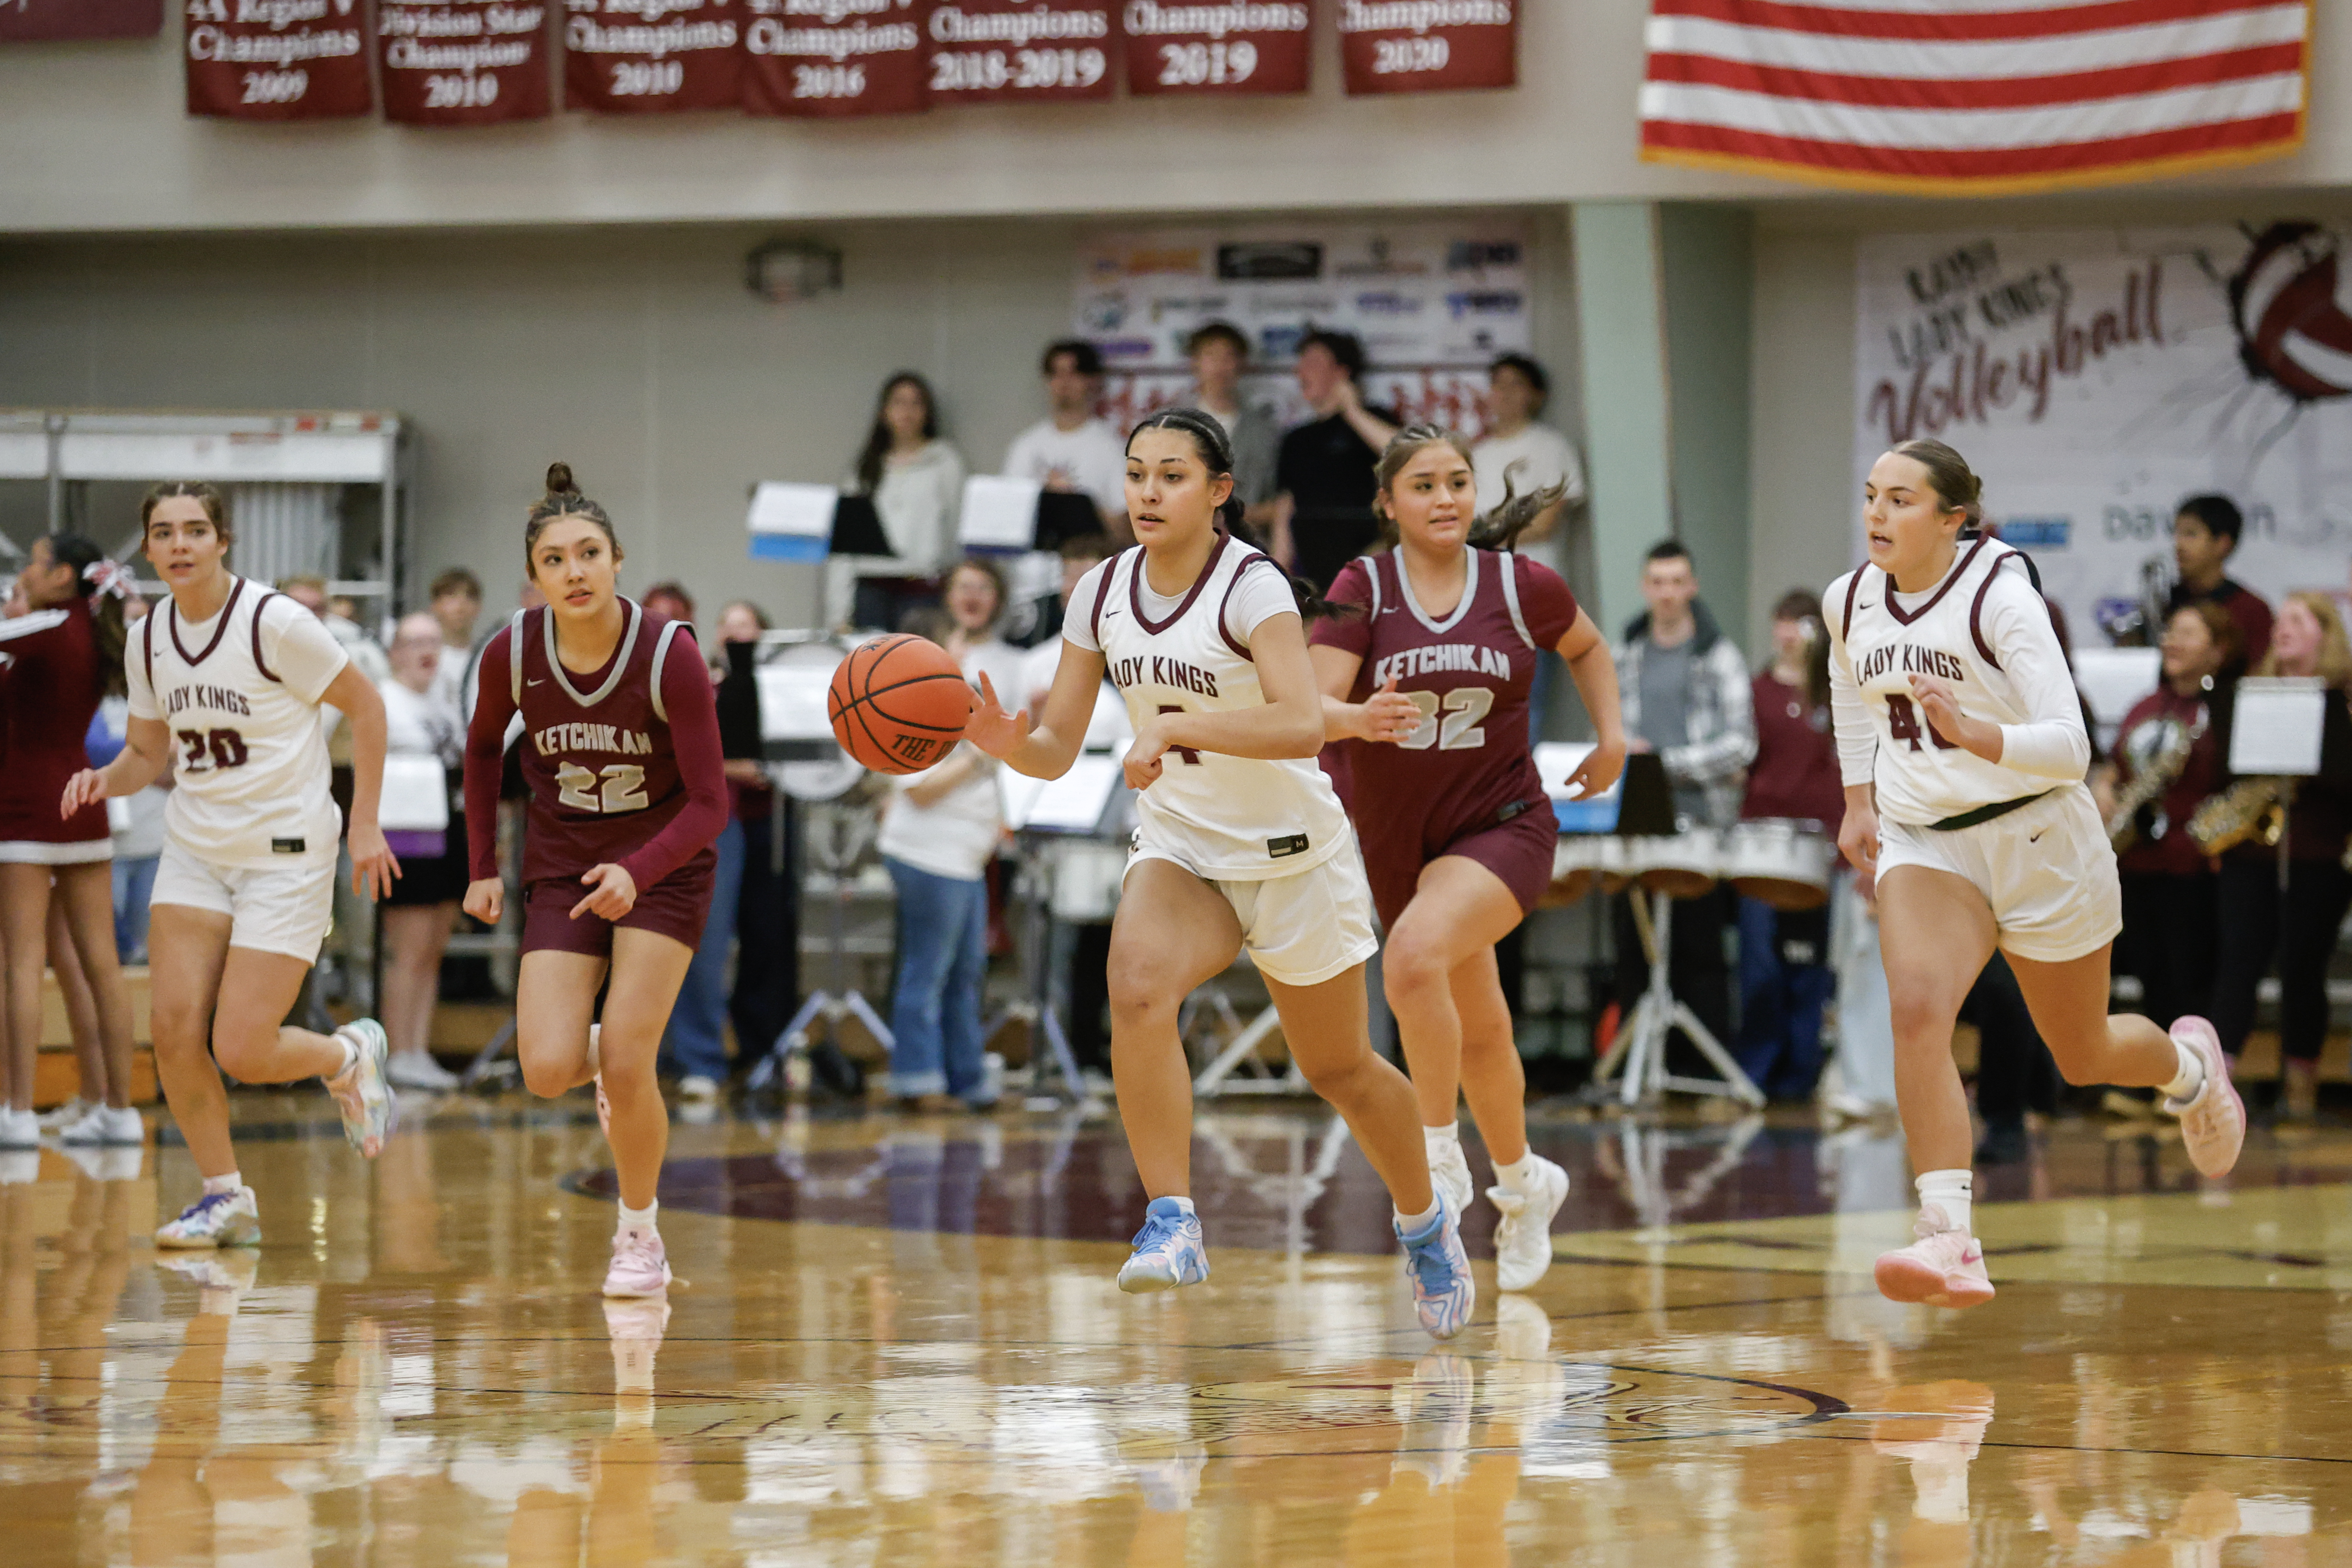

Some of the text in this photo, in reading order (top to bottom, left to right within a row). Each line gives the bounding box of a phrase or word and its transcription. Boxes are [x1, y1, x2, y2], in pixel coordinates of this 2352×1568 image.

[565, 15, 738, 59] Champions
[746, 17, 918, 63] Champions
[928, 4, 1108, 46] Champions
[1123, 0, 1309, 39] Champions
[190, 25, 361, 68] Champions
[386, 38, 532, 76] Champion
[1157, 40, 1258, 85] 2019
[1372, 36, 1450, 74] 2020
[423, 72, 499, 108] 2010
[610, 60, 684, 96] 2010
[792, 63, 866, 98] 2016
[929, 47, 1107, 90] 2018-2019
[1866, 254, 2166, 444] Volleyball
[1115, 655, 1219, 698] ADY KINGS
[1374, 644, 1511, 688] KETCHIKAN
[1856, 643, 1964, 687] LADY KINGS
[163, 684, 250, 716] ADY KINGS
[177, 727, 248, 773] 20
[535, 722, 653, 756] KETCHIKAN
[892, 734, 936, 762] THE
[554, 761, 649, 814] 22
